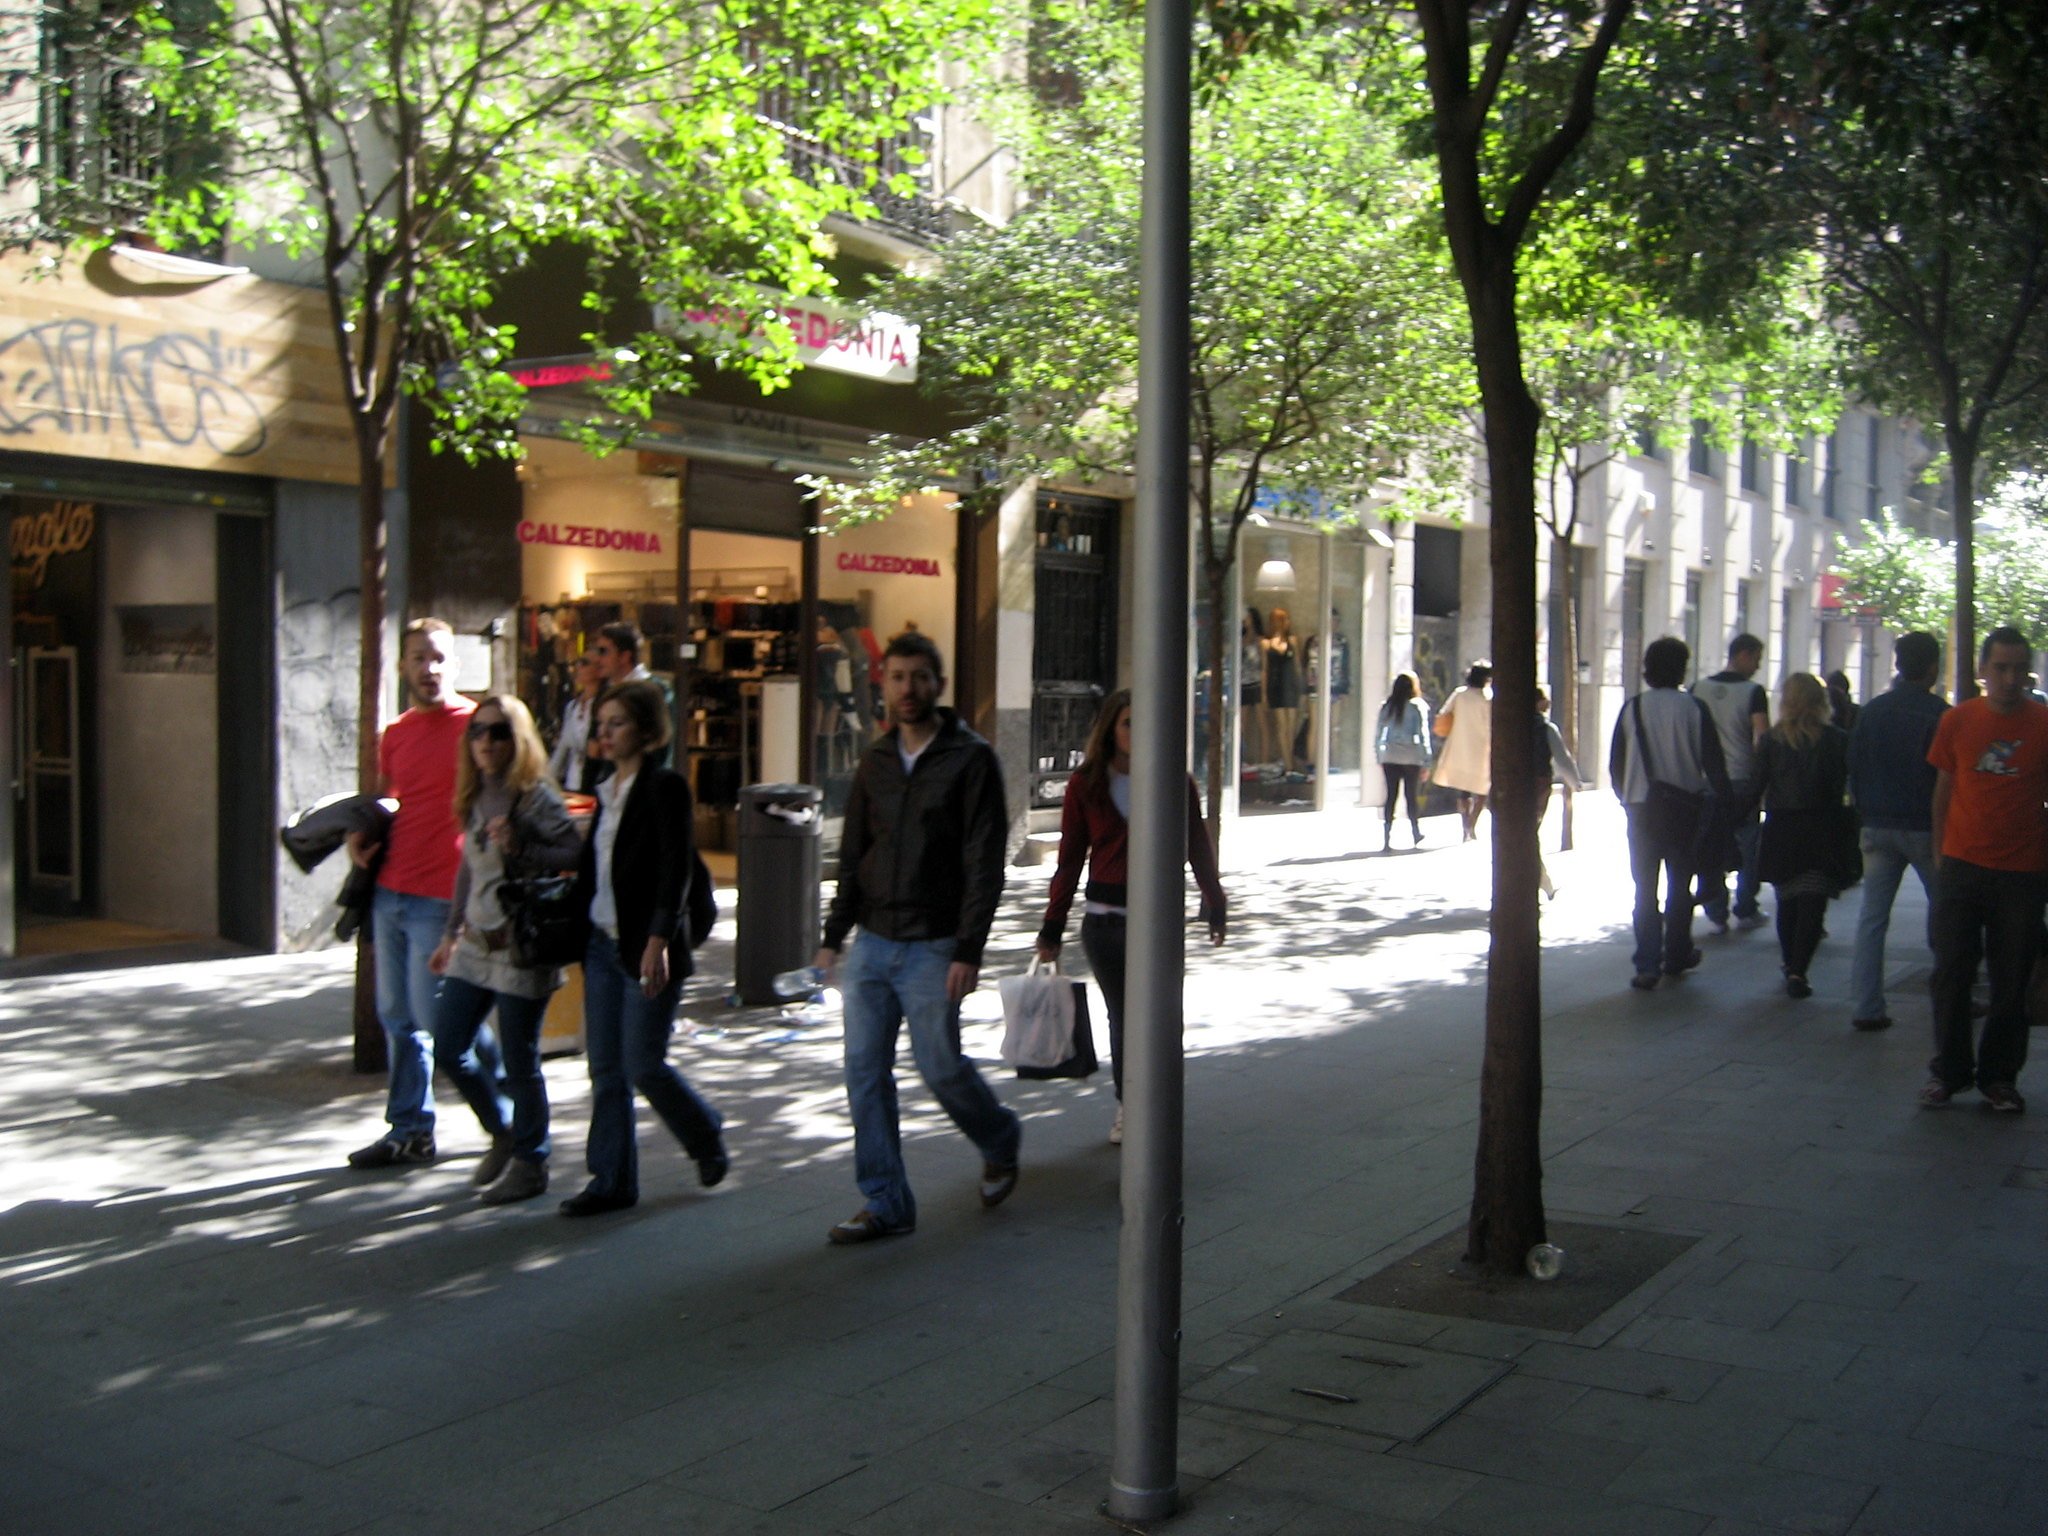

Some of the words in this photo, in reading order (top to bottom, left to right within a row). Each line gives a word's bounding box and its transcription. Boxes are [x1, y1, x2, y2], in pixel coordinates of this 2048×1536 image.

[684, 290, 908, 368] EDONIA
[516, 519, 661, 554] CALZEDONIA
[837, 552, 941, 577] CALZEDONIA
